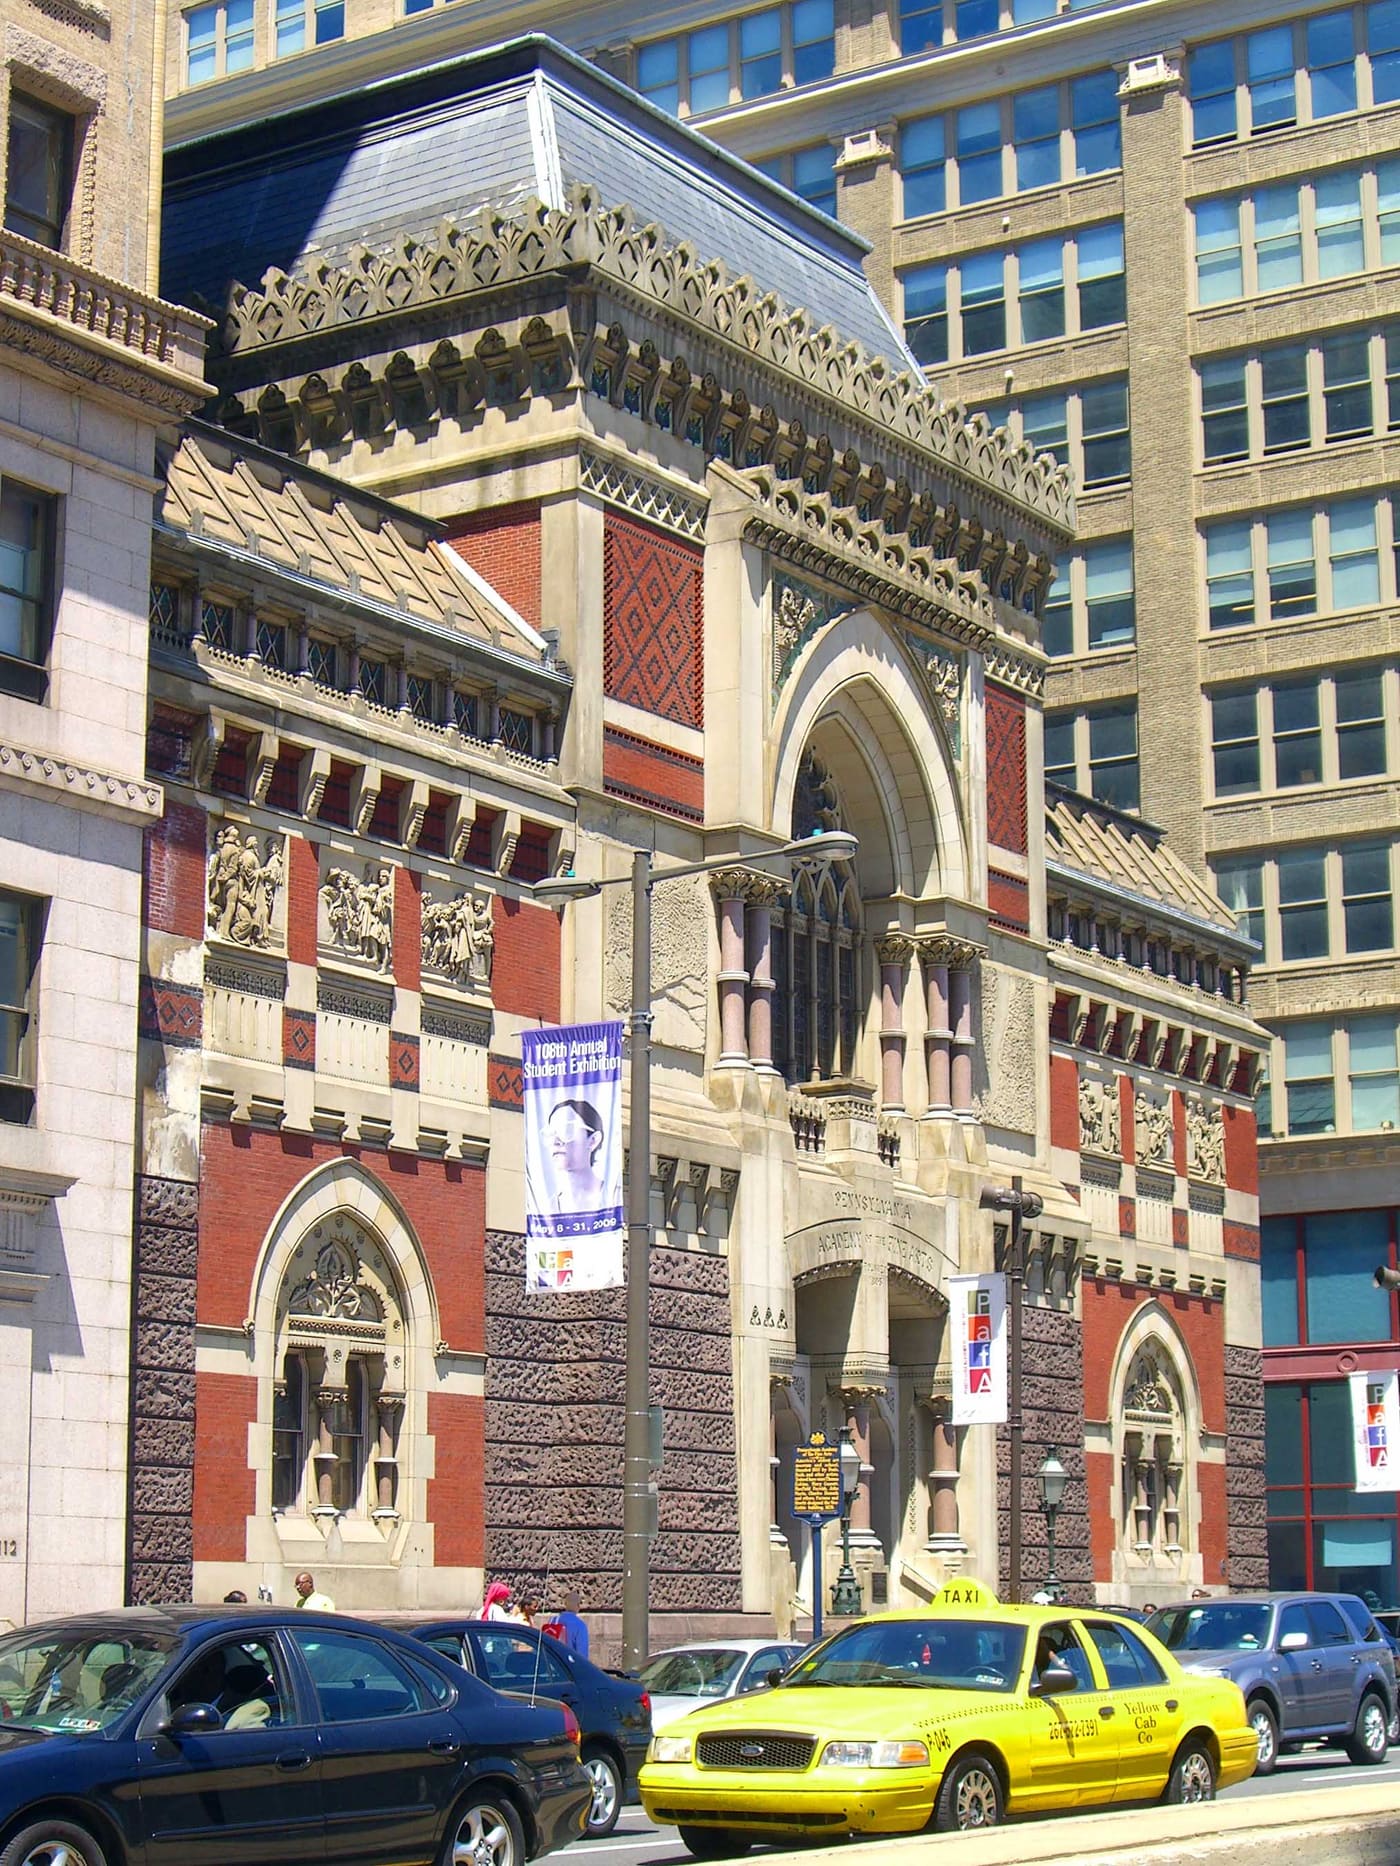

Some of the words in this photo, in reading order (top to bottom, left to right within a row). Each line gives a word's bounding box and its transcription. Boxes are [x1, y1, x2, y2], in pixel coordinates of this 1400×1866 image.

[536, 1042, 567, 1060] 108th
[570, 1036, 607, 1057] Annual
[524, 1050, 567, 1078] Student
[569, 1054, 621, 1075] Exhibition
[530, 1223, 554, 1235] May
[556, 1224, 564, 1233] 8
[593, 1218, 617, 1230] 2009
[818, 1231, 862, 1254] ACADEMY
[943, 1590, 979, 1603] TAXI
[1124, 1702, 1160, 1715] Yellow
[1135, 1715, 1157, 1730] Cab
[926, 1728, 951, 1752] P-046
[1138, 1731, 1153, 1744] Co
